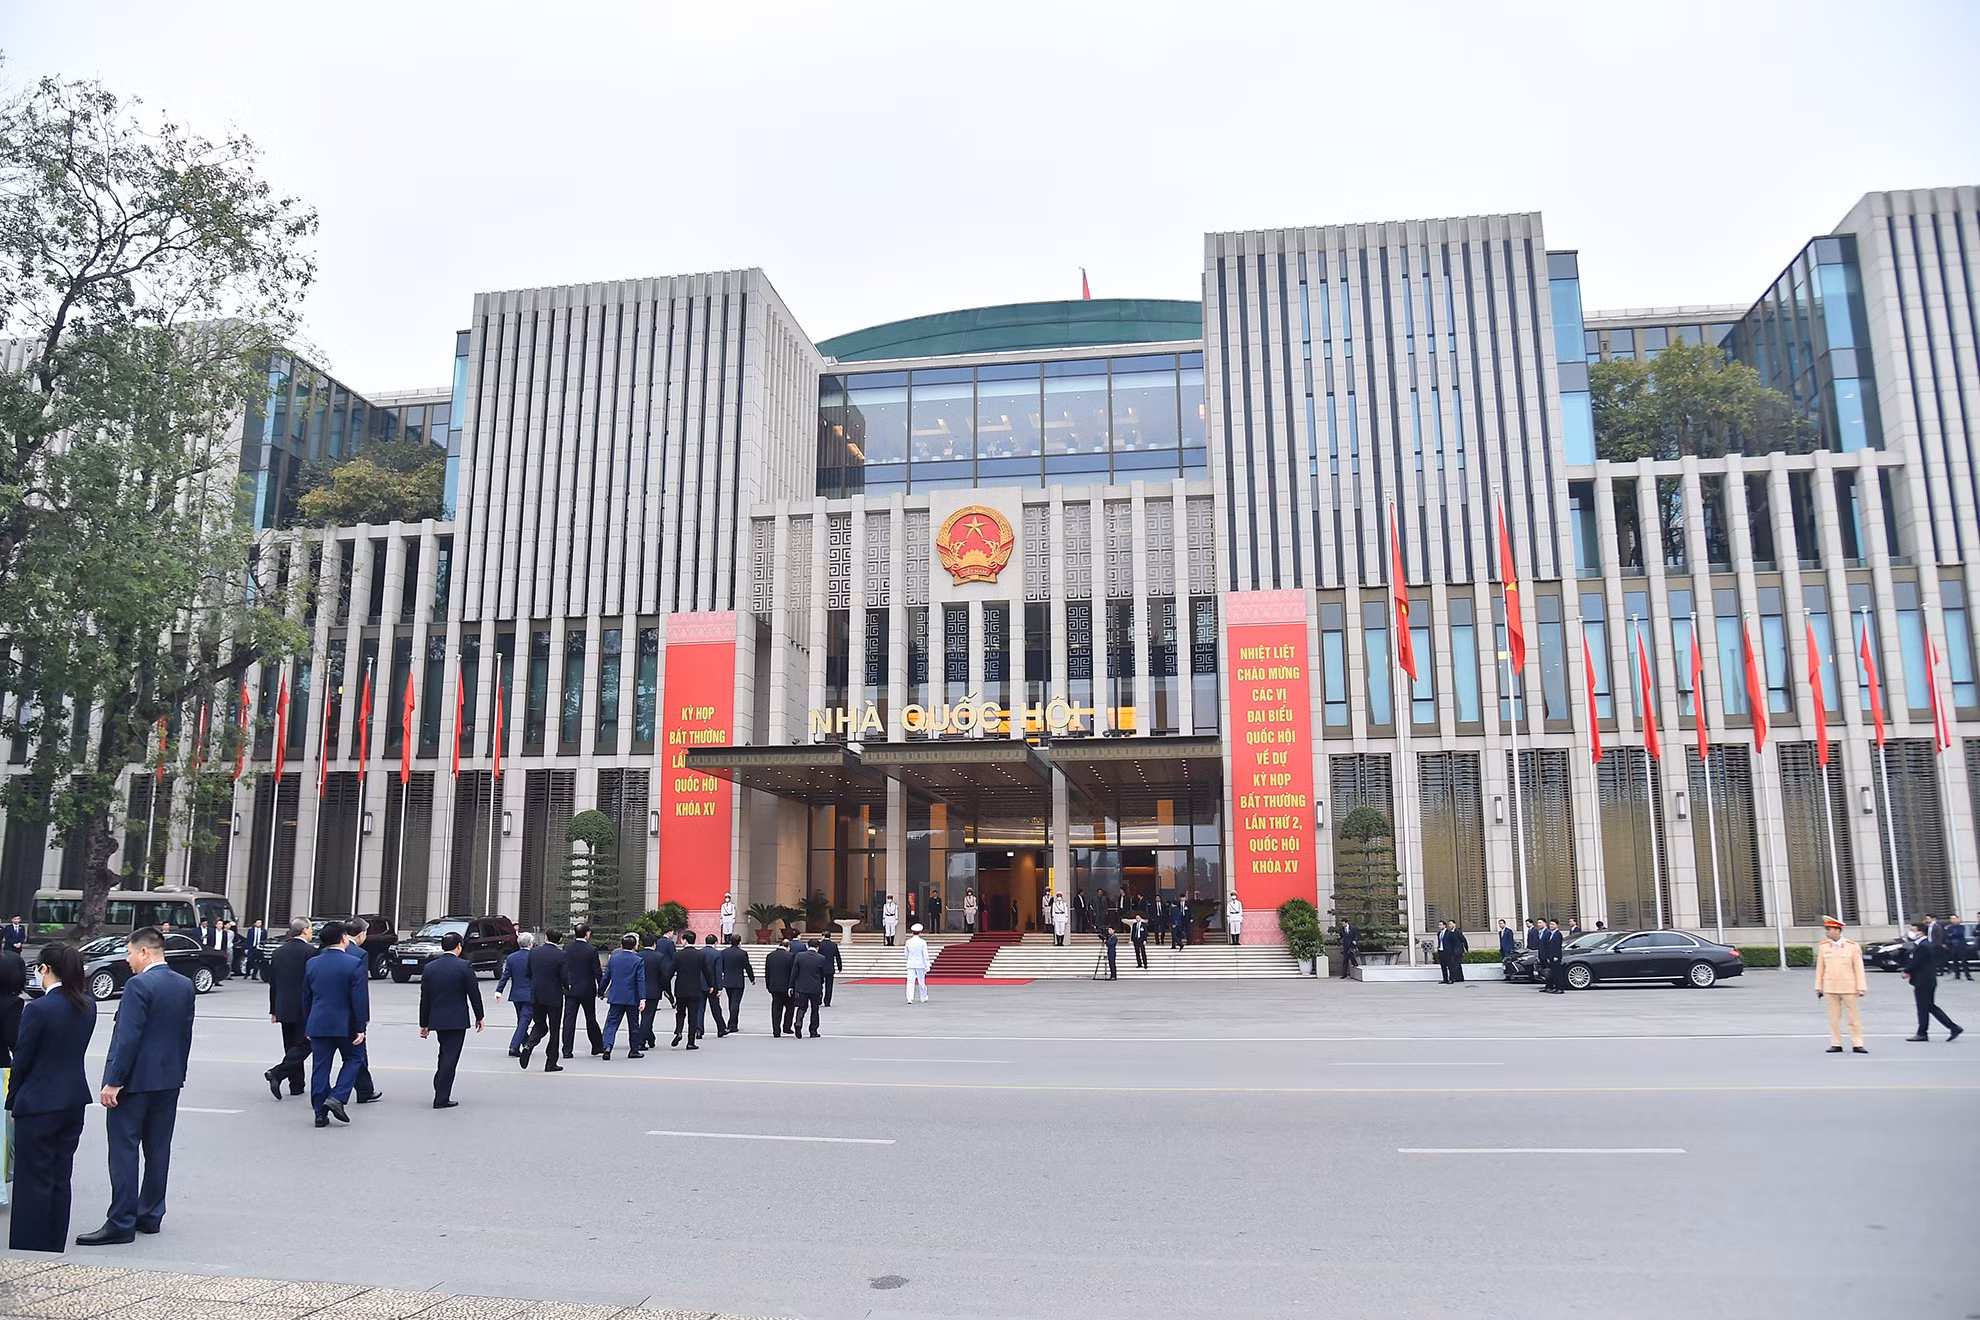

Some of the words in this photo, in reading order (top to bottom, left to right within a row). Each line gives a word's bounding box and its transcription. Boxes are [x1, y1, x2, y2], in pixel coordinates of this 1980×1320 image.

[1240, 646, 1271, 661] NHIỆT
[1273, 645, 1296, 660] LIỆT
[1237, 666, 1266, 681] CHÀO
[1268, 665, 1300, 680] MỪNG
[1252, 686, 1274, 702] CÁC
[1276, 689, 1287, 704] VỊ
[681, 705, 694, 722] KỲ
[696, 706, 715, 722] HỌP
[811, 699, 884, 734] NHÀ
[900, 692, 1002, 733] QUỐC
[1020, 696, 1081, 735] HỘI
[1247, 709, 1266, 725] ĐẠI
[1268, 704, 1293, 723] BIỂU
[670, 727, 688, 745] BẤT
[689, 727, 726, 745] THƯỜNG
[1246, 727, 1275, 745] QUỐC
[1278, 728, 1296, 746] HỘI
[672, 751, 686, 769] LẦ
[1256, 748, 1270, 766] VỀ
[1272, 750, 1288, 767] DỰ
[674, 775, 700, 794] QUỐC
[701, 776, 718, 795] HỘI
[1253, 770, 1268, 787] KỲ
[1270, 772, 1292, 789] HỌP
[675, 800, 701, 817] KHÓA
[703, 802, 716, 816] XV
[1240, 791, 1261, 809] BẤT
[1263, 791, 1307, 808] THƯỜNG
[1245, 812, 1267, 830] LẦN
[1269, 813, 1290, 830] THỨ
[1292, 816, 1303, 831] 2,
[1249, 833, 1279, 854] QUỐC
[1281, 834, 1300, 854] HỘI
[1252, 855, 1282, 874] KHÓA
[1284, 859, 1299, 873] XV
